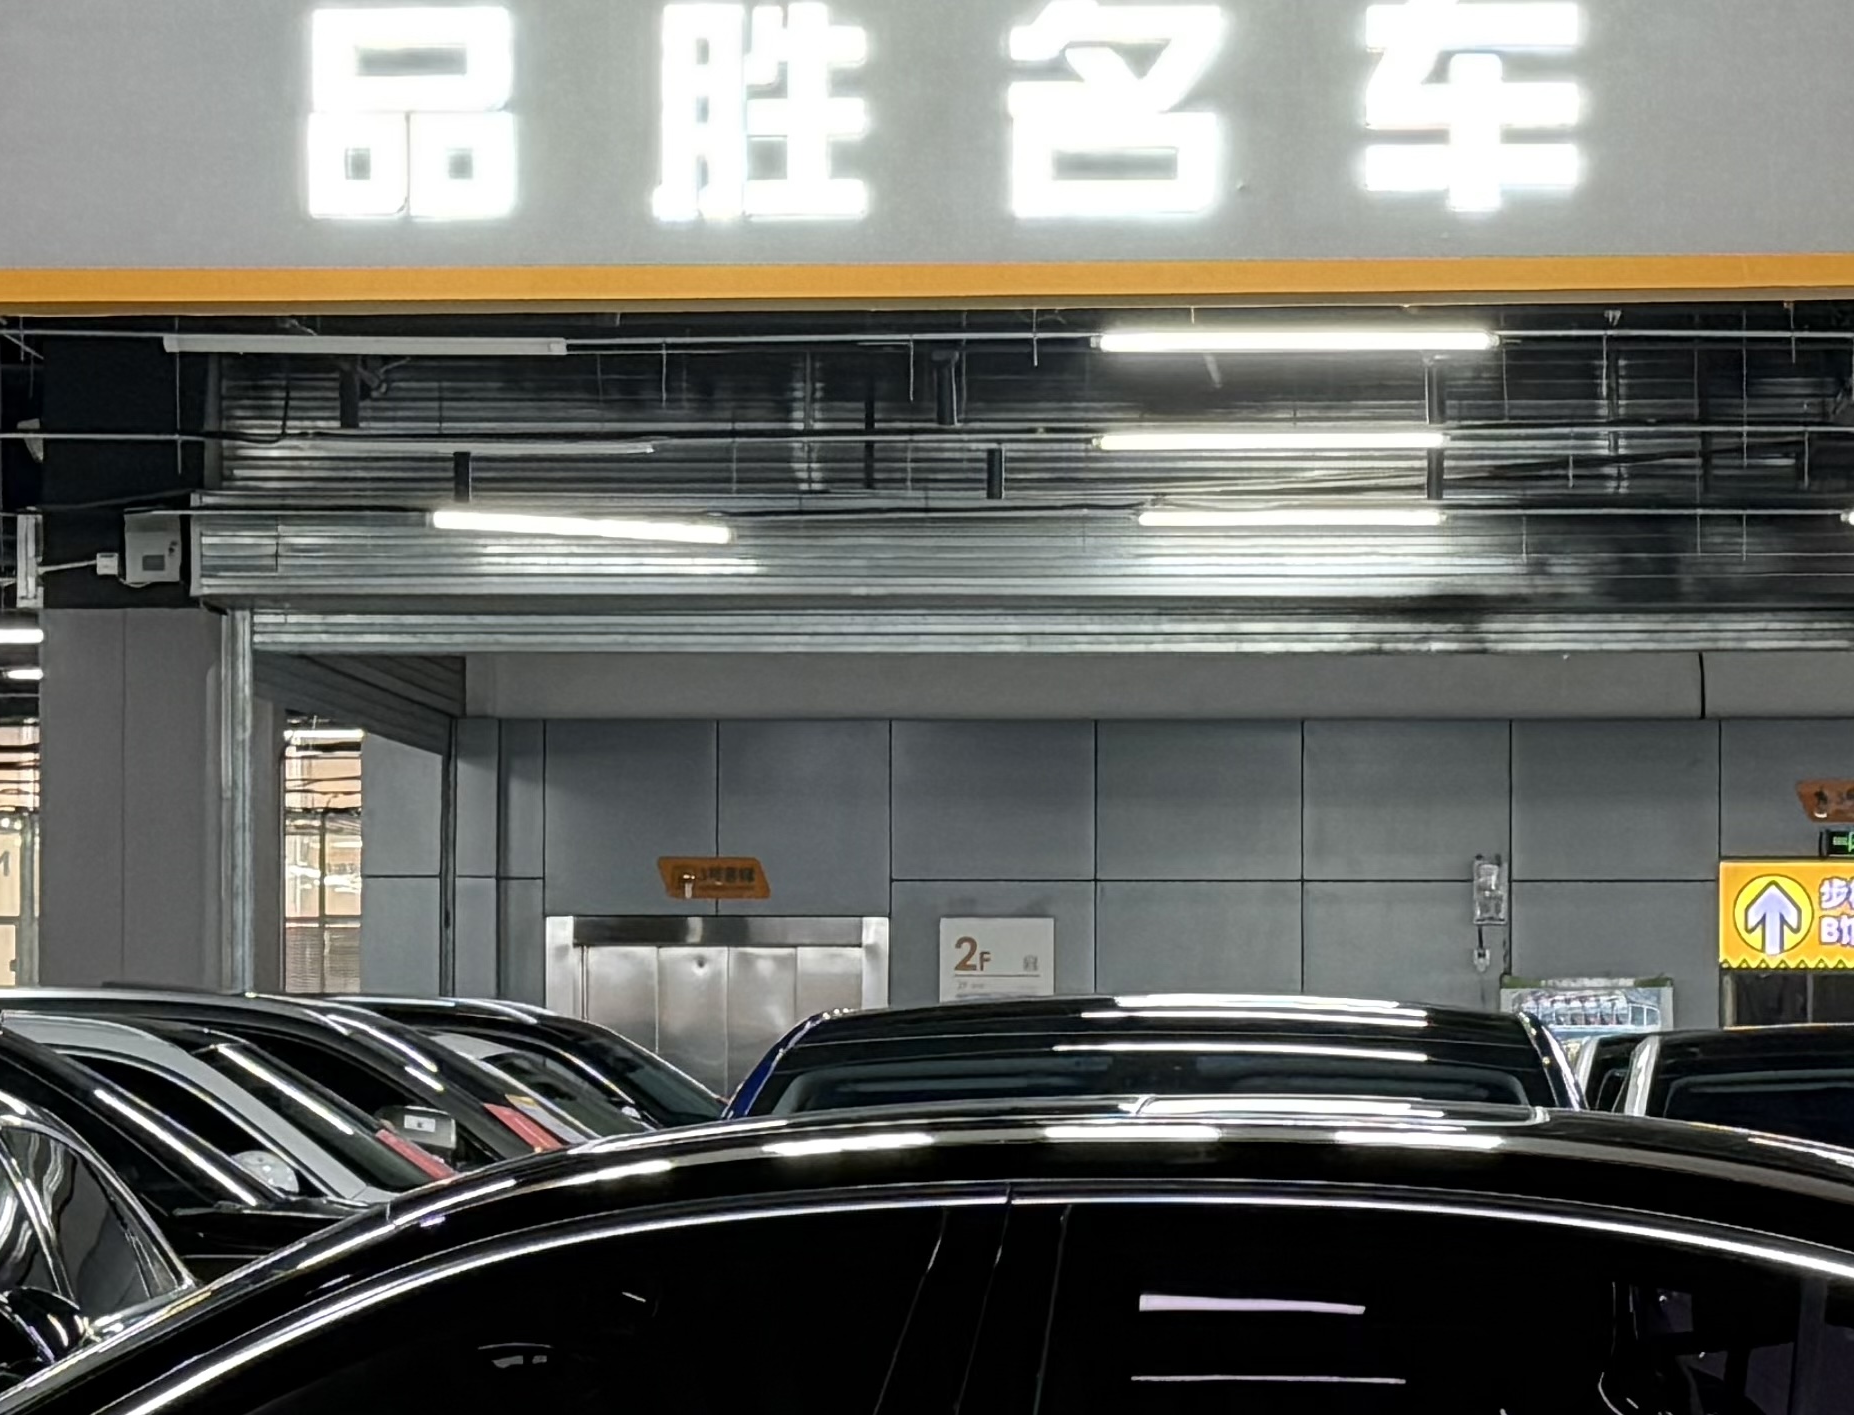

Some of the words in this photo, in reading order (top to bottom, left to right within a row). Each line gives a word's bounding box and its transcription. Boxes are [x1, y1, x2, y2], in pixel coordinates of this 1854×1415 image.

[307, 0, 1582, 220] 品胜名车
[954, 935, 991, 972] 2F
